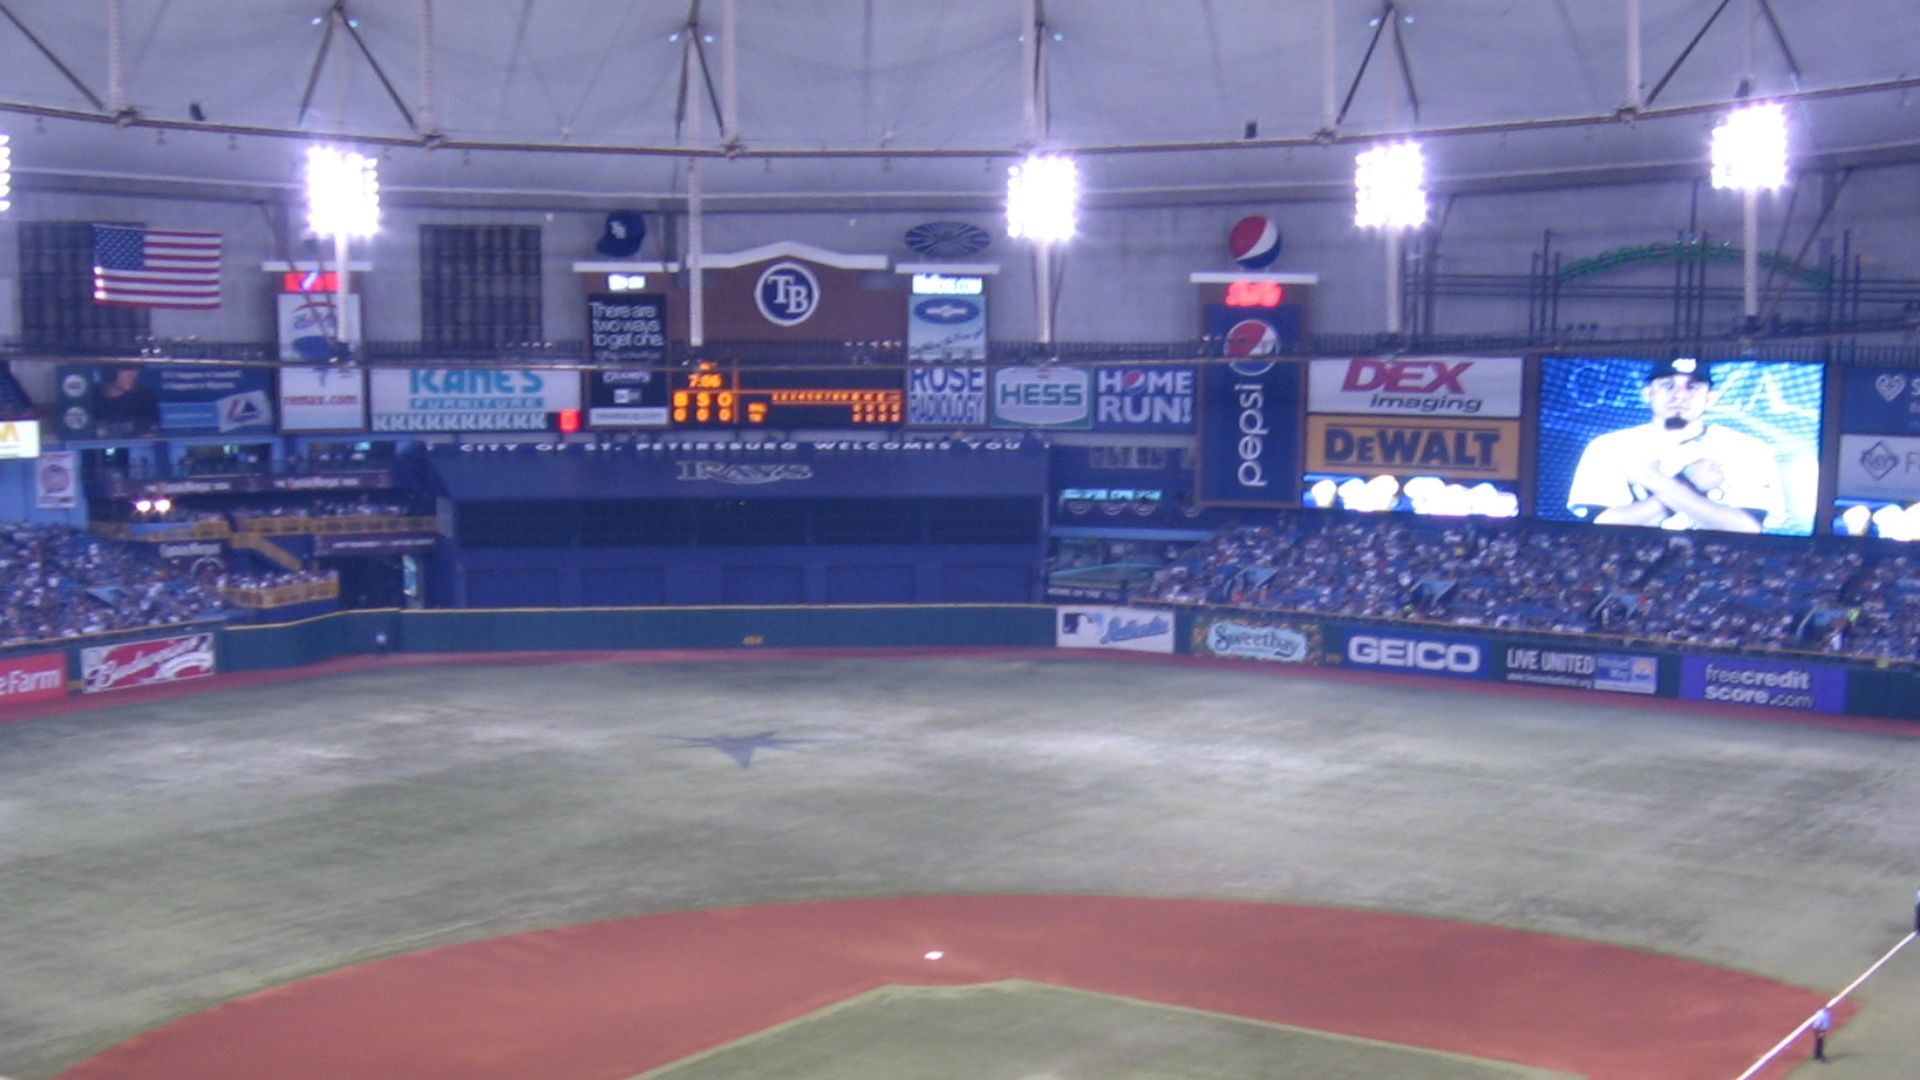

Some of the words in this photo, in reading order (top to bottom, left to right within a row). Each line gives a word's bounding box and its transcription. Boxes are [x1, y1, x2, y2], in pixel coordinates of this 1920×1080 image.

[766, 275, 810, 314] TB
[589, 302, 630, 318] There
[632, 305, 657, 318] are
[592, 320, 619, 332] two
[620, 320, 660, 334] ways
[592, 333, 607, 346] to
[608, 333, 632, 350] get
[1099, 369, 1193, 395] HOME
[1341, 358, 1475, 394] DEX
[1001, 383, 1082, 406] HESS
[1369, 394, 1484, 412] imaging
[1099, 397, 1193, 423] RUN!
[460, 443, 518, 451] CITY
[535, 443, 568, 451] OF
[584, 443, 621, 451] ST.
[636, 442, 798, 450] PETERSBURG
[814, 441, 952, 450] WELCOMES
[968, 440, 1021, 450] YOU
[1236, 383, 1267, 487] pepsi
[1214, 623, 1302, 657] Sweetbay
[1348, 635, 1481, 673] GEICO
[1506, 650, 1538, 670] LIVE
[1541, 651, 1594, 674] UNITED
[1705, 663, 1812, 690] freecredit
